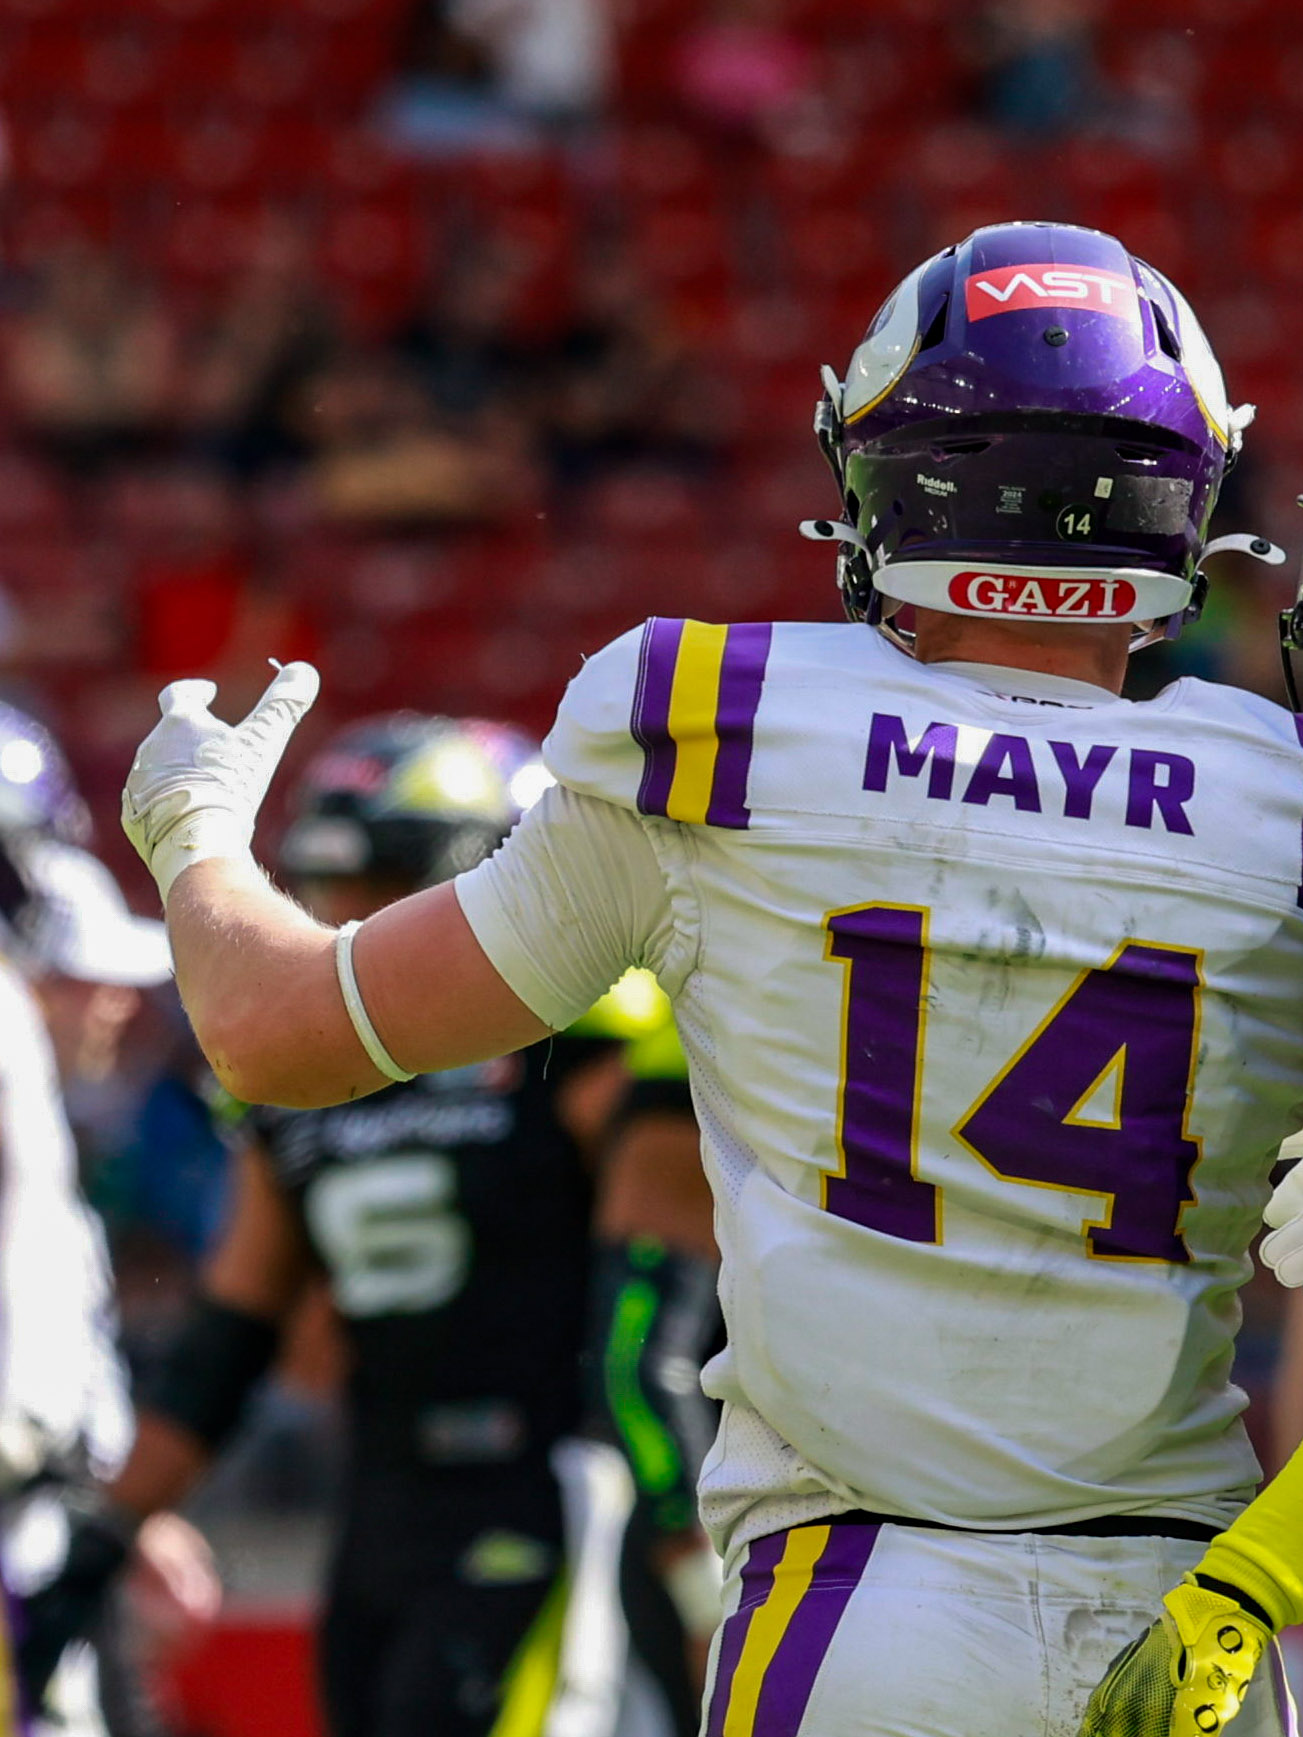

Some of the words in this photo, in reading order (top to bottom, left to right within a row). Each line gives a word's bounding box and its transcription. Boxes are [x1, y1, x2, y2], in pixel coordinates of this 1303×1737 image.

[975, 271, 1127, 305] VAST
[917, 473, 954, 492] Riddell
[1063, 513, 1092, 535] 14
[861, 712, 1196, 837] MAYR
[818, 899, 1206, 1264] 14
